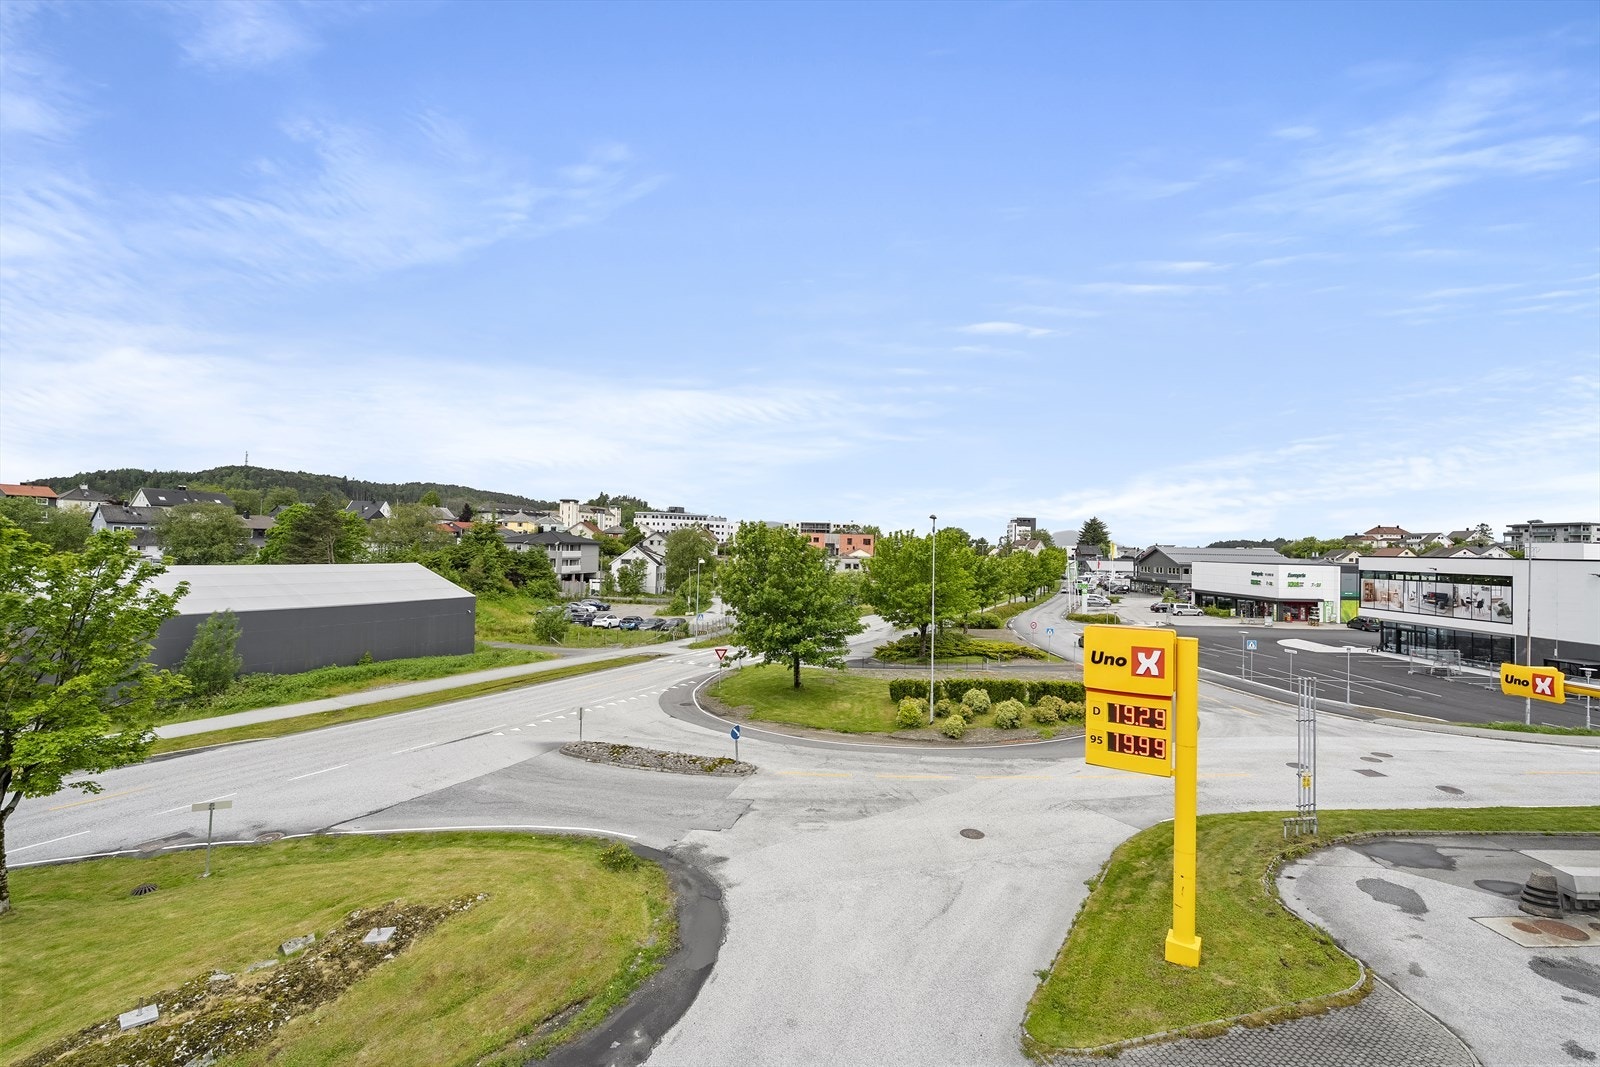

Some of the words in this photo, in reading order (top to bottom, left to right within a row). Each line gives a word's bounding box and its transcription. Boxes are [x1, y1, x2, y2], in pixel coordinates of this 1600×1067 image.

[1091, 650, 1128, 667] Uno
[1135, 650, 1162, 676] X
[1505, 674, 1529, 687] Uno
[1535, 676, 1553, 696] X
[1092, 706, 1101, 716] D
[1114, 703, 1167, 730] 19.29
[1090, 734, 1104, 745] 95
[1113, 732, 1167, 760] 19.99
